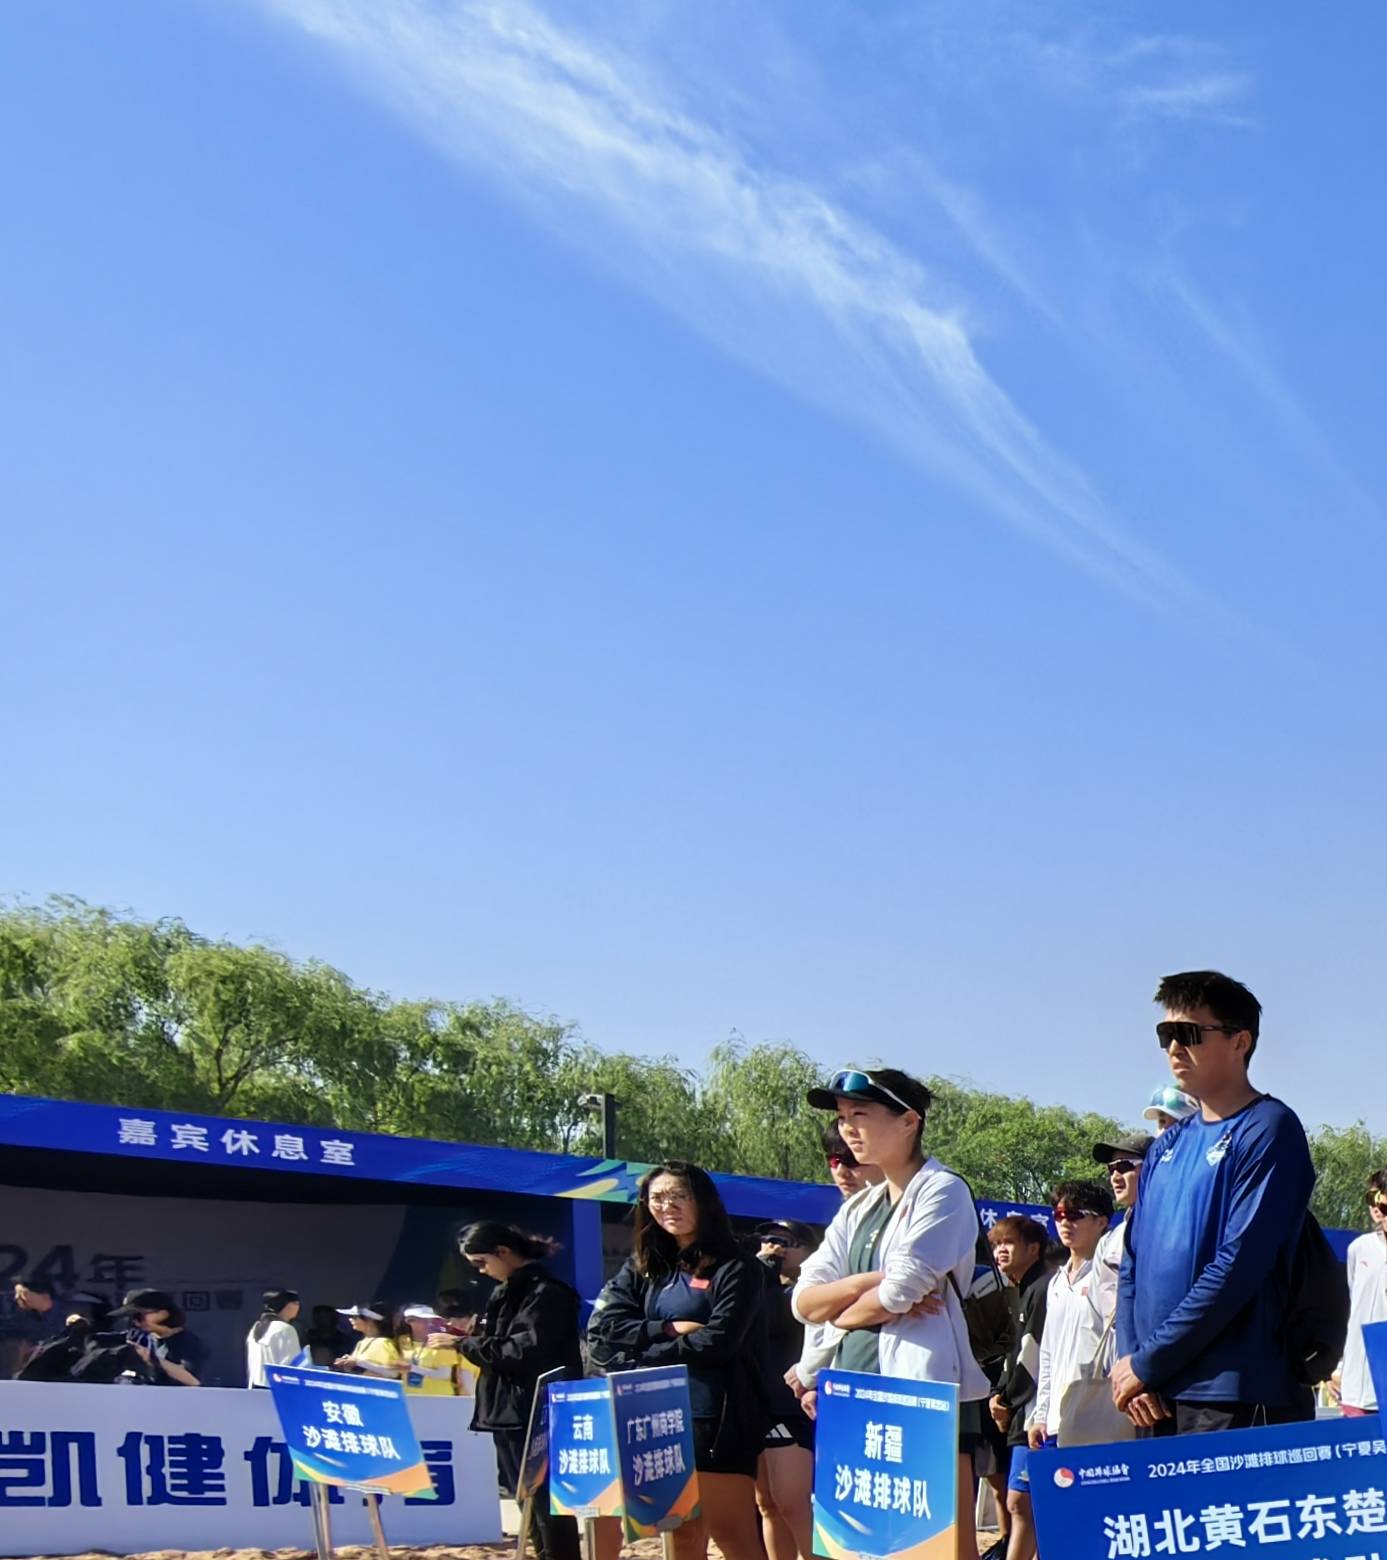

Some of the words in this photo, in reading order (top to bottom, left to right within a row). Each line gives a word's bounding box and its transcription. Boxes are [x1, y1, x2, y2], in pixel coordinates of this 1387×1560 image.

[117, 1118, 355, 1166] 嘉宾休息室
[322, 1400, 364, 1427] 安徽
[572, 1414, 594, 1441] 云南
[302, 1425, 401, 1460] 沙滩排球队
[864, 1421, 903, 1463] 新疆
[559, 1448, 611, 1475] 沙滩排球队
[632, 1443, 686, 1486] 沙滩排球队
[835, 1464, 932, 1521] 沙滩排球队
